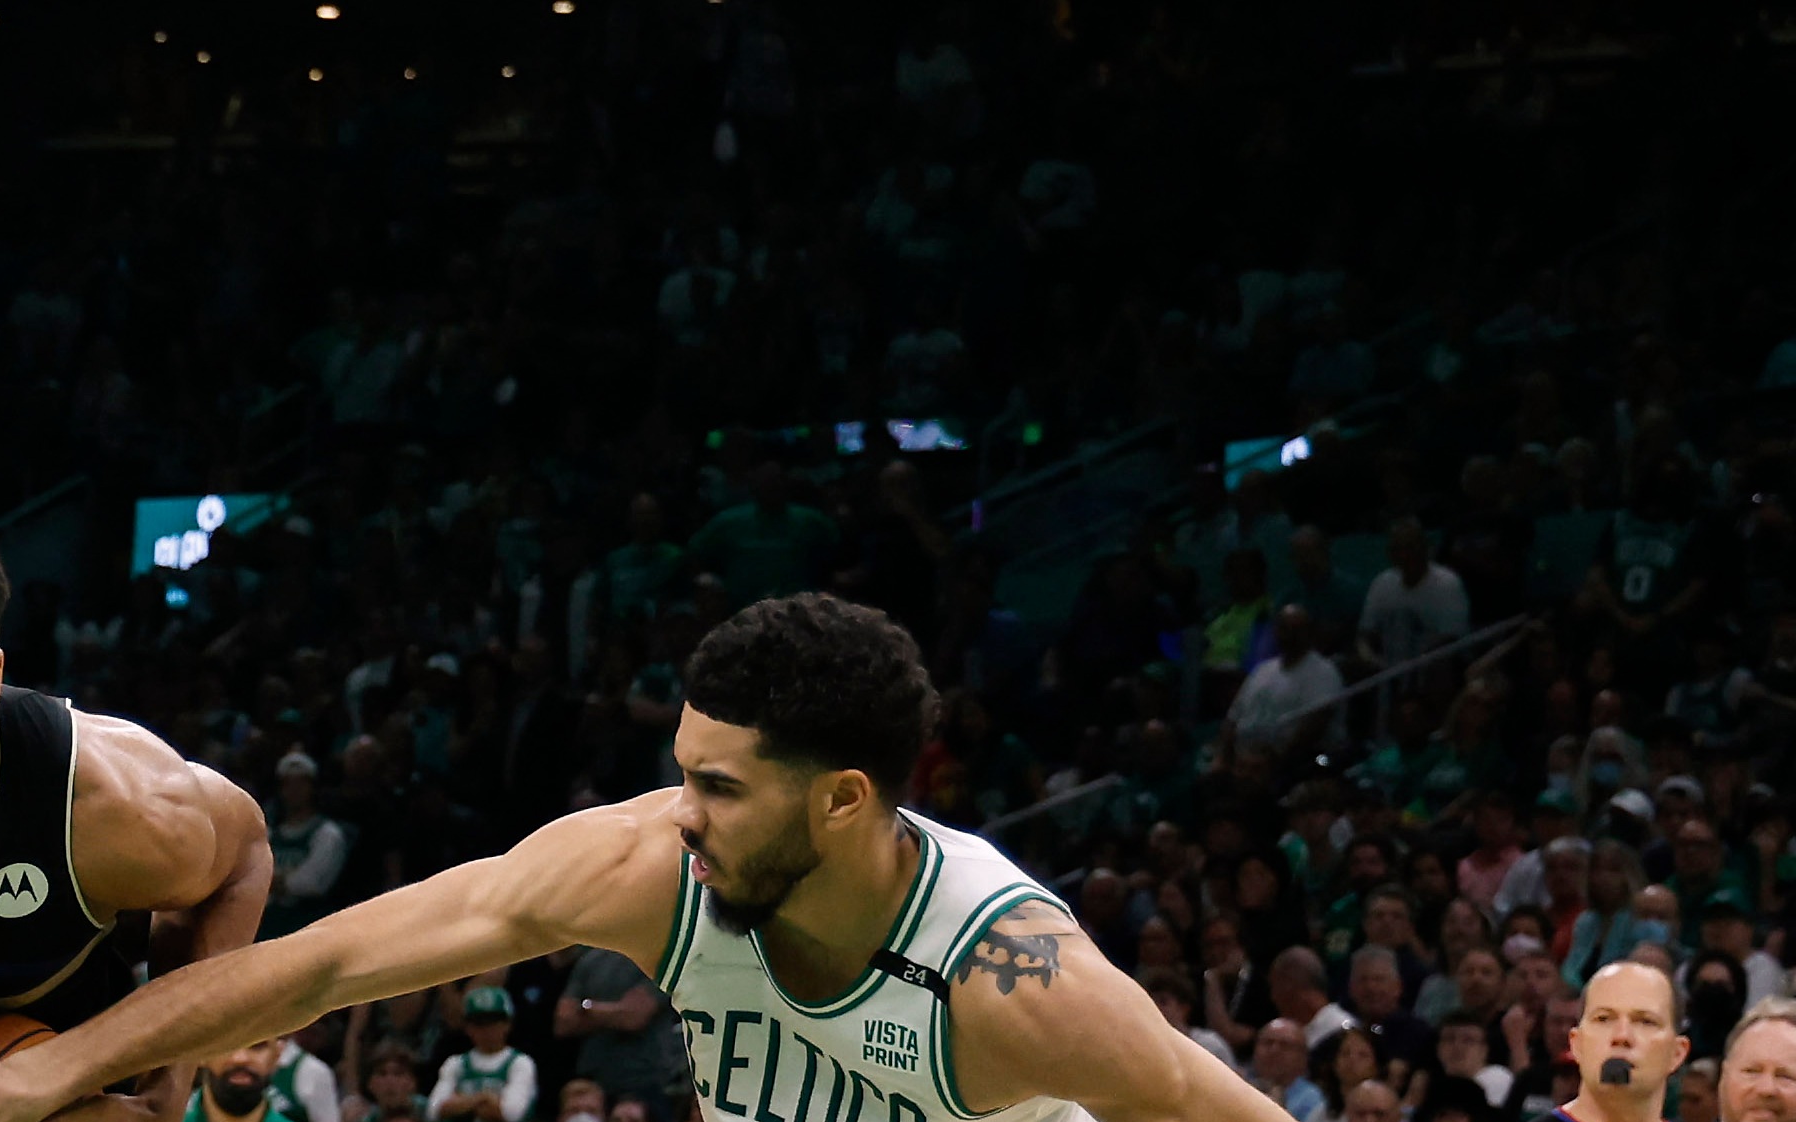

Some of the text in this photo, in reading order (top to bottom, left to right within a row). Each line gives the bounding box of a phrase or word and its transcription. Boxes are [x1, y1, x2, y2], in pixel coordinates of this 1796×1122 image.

[903, 964, 927, 985] 24
[864, 1019, 919, 1056] VISTA
[862, 1044, 920, 1072] PRINT
